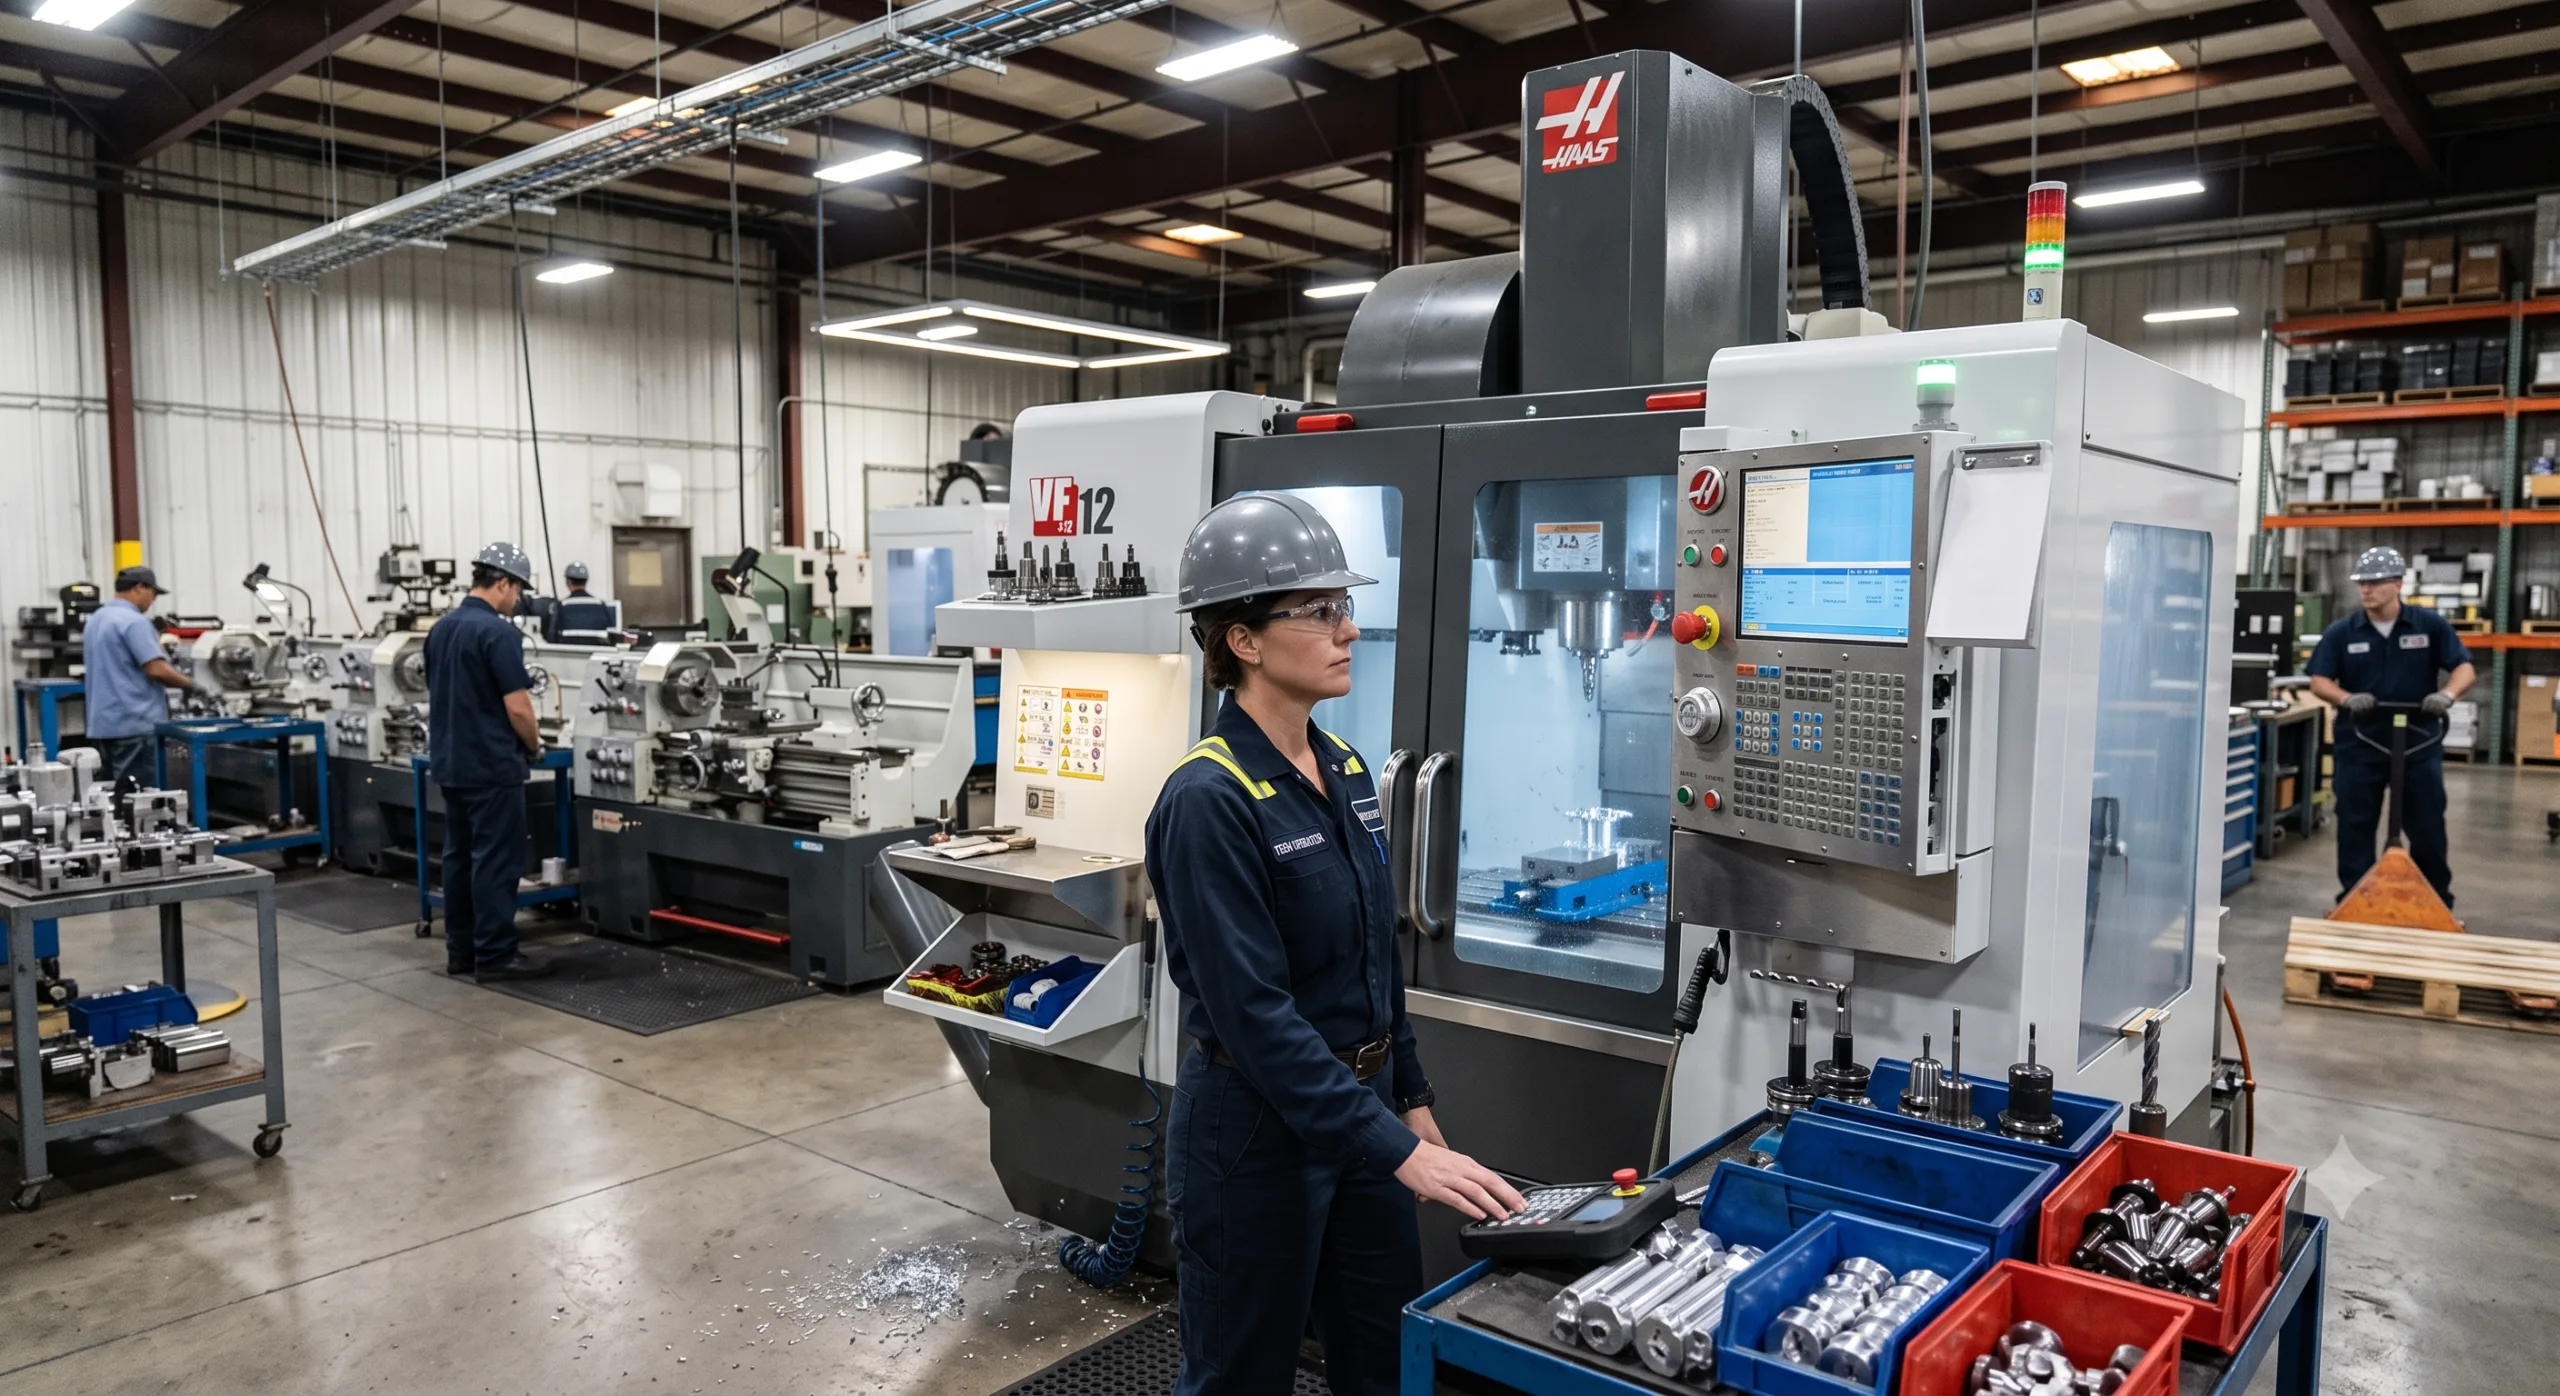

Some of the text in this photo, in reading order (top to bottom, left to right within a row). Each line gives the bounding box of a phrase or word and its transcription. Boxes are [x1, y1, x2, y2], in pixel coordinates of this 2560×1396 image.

[1542, 136, 1619, 169] HAAS
[1030, 477, 1115, 535] VF 12
